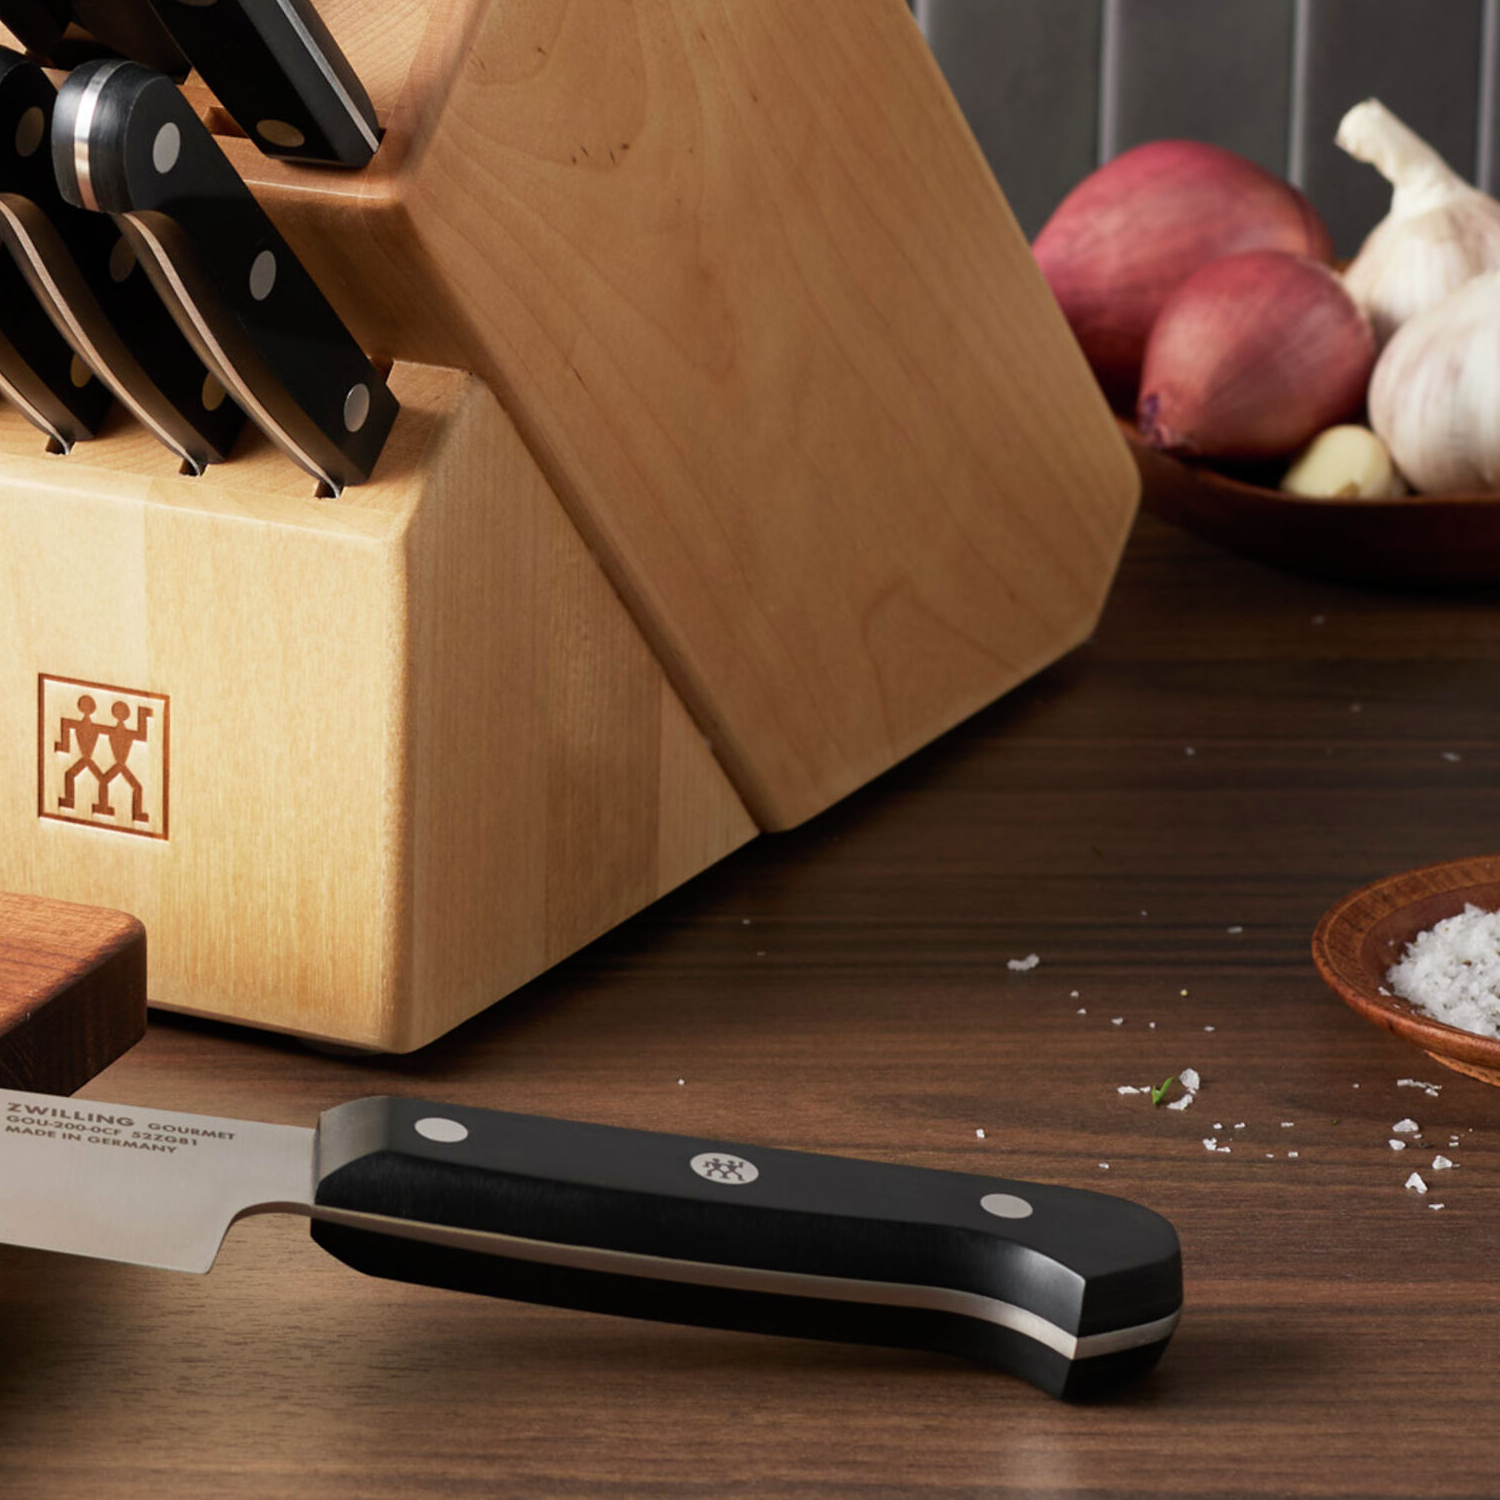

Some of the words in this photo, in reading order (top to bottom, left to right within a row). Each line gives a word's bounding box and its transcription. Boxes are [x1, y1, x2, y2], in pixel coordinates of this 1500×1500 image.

[7, 1102, 135, 1127] ZWILLING
[147, 1122, 236, 1140] GOURMET
[5, 1125, 56, 1138] MADE
[62, 1132, 81, 1141] IN
[87, 1136, 177, 1154] GERMANY
